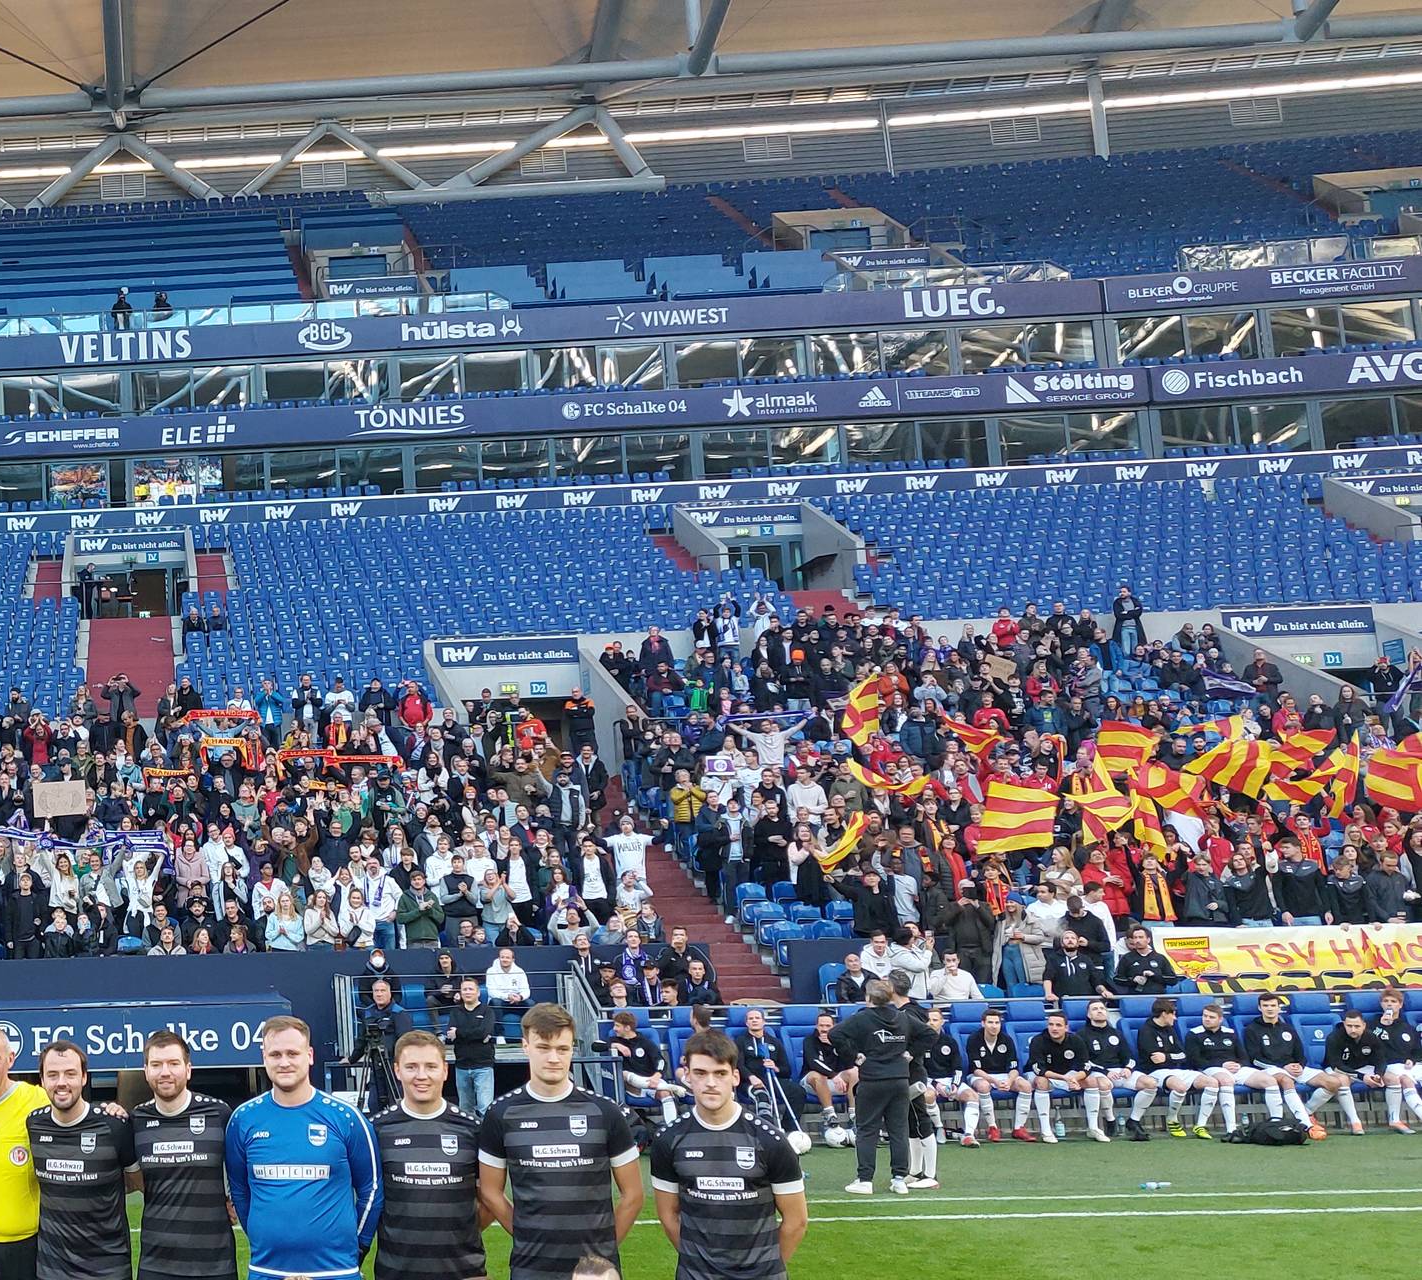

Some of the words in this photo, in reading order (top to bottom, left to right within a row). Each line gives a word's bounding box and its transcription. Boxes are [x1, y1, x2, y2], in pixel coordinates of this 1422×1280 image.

[1271, 269, 1339, 284] BECKER
[1342, 265, 1402, 279] FACILITY
[329, 285, 353, 295] R+V
[1129, 285, 1172, 298] BLEKER
[1194, 282, 1238, 293] GRUPPE
[1300, 285, 1348, 294] Management
[1350, 283, 1374, 292] GmbH
[904, 288, 1005, 317] LUEG.
[641, 308, 729, 326] VIVAWEST
[402, 321, 495, 340] hülsta
[59, 329, 192, 364] VELTINS
[1034, 373, 1134, 392] Stölting
[1195, 367, 1303, 389] Fischbach
[756, 391, 816, 408] almaak
[859, 399, 891, 408] adidas
[1046, 394, 1093, 403] SERVICE
[1095, 392, 1135, 400] GROUP
[584, 403, 604, 416] FC
[607, 400, 666, 415] Schalke
[669, 400, 687, 413] 04
[757, 405, 818, 414] international
[355, 405, 465, 429] TÖNNIES
[25, 428, 119, 442] SCHEFFER
[162, 427, 202, 446] ELE
[1259, 458, 1293, 473] R+V
[906, 476, 938, 491] R+V
[564, 492, 596, 506] R+V
[200, 509, 231, 522] R+V
[736, 515, 749, 523] bist
[752, 514, 770, 522] nicht
[773, 513, 797, 521] allein.
[81, 538, 108, 550] R+V
[158, 540, 180, 548] allein.
[1290, 622, 1305, 631] bist
[1308, 621, 1328, 630] nicht
[1331, 620, 1368, 629] allein.
[443, 645, 479, 661] R+V
[498, 652, 513, 660] bist
[538, 650, 573, 659] allein.
[1327, 654, 1340, 663] D1
[532, 683, 546, 692] D2
[1237, 941, 1315, 968] TSV
[146, 1120, 160, 1128] JAKO
[520, 1121, 538, 1129] JAKO
[159, 1155, 174, 1163] rund
[175, 1154, 190, 1162] um's
[192, 1152, 208, 1160] Haus
[543, 1160, 560, 1168] rund
[561, 1159, 578, 1168] um's
[579, 1157, 594, 1165] Haus
[51, 1173, 65, 1181] rund
[82, 1173, 98, 1181] Haus
[431, 1177, 447, 1185] um's
[448, 1175, 462, 1183] Haus
[709, 1192, 724, 1200] rund
[726, 1193, 742, 1201] um's
[743, 1191, 758, 1199] Haus
